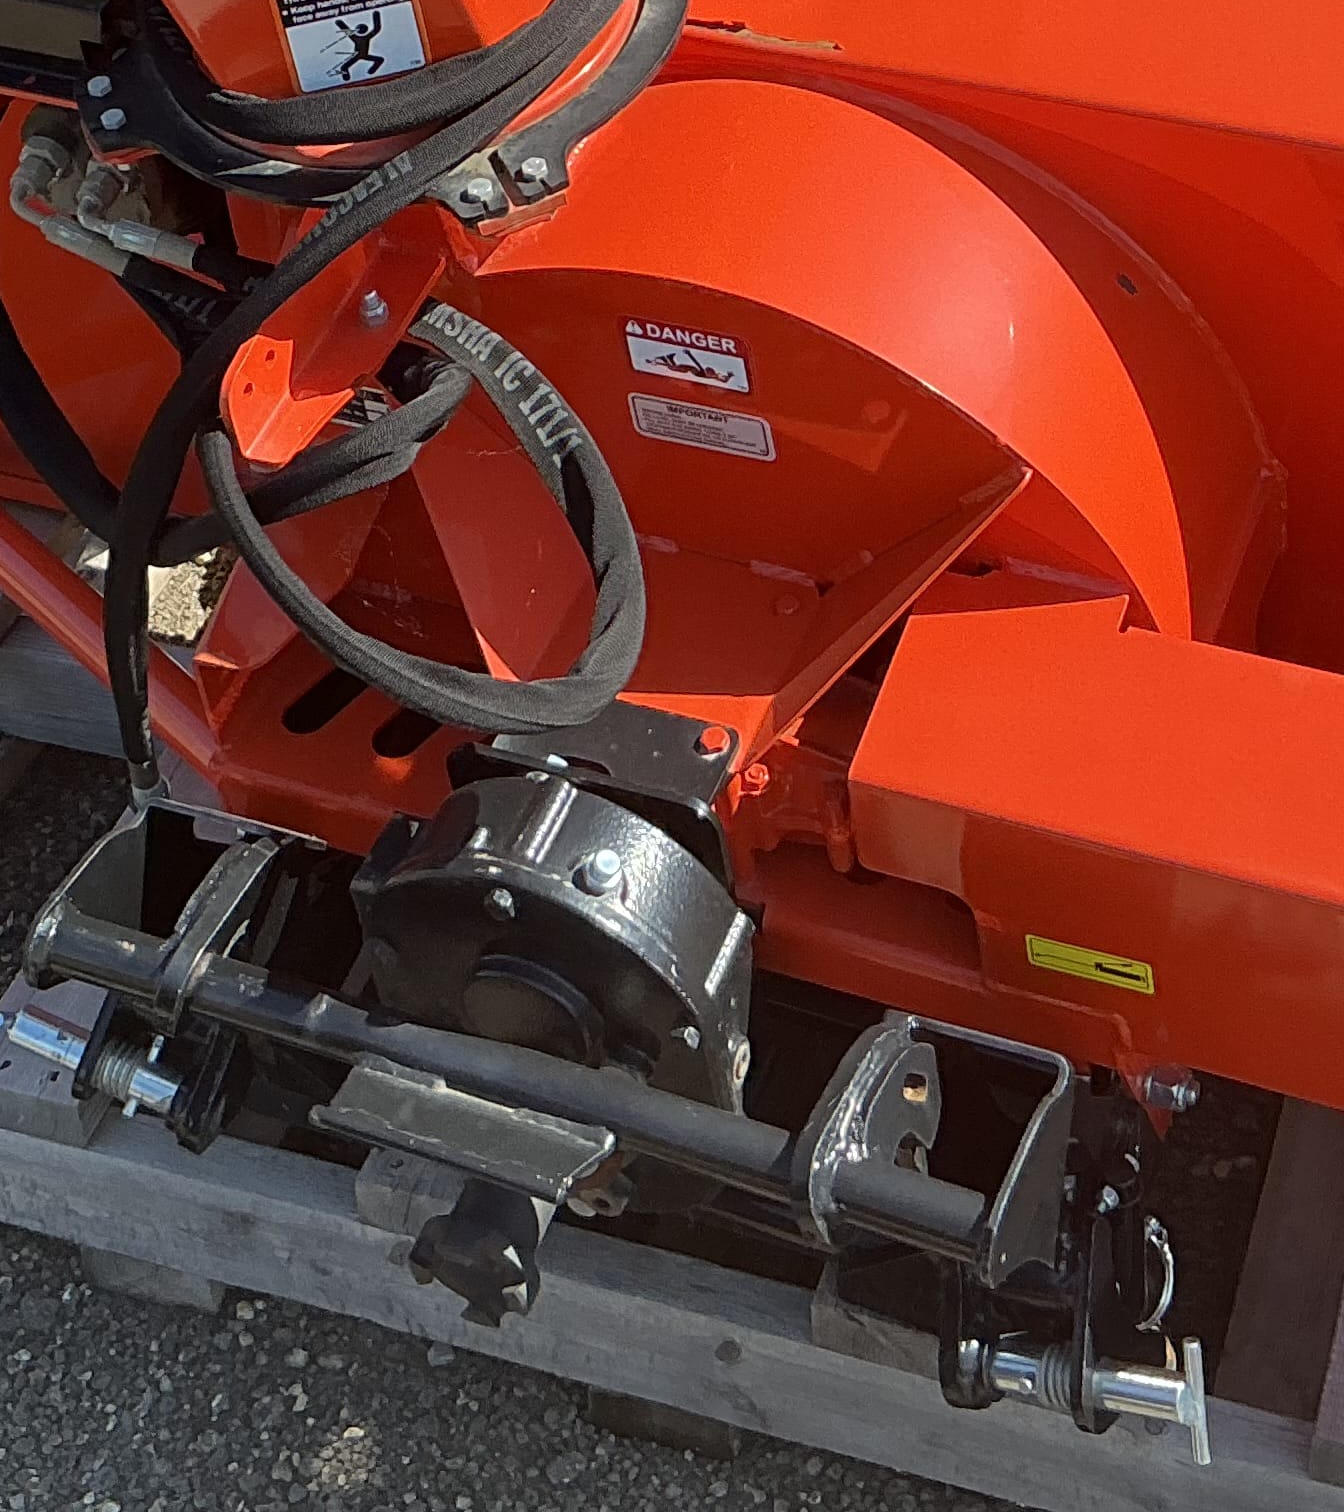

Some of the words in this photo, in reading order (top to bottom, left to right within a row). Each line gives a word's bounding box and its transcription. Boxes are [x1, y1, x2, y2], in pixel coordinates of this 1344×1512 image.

[290, 3, 316, 15] Keep
[340, 2, 364, 14] from
[645, 323, 738, 354] DANGER
